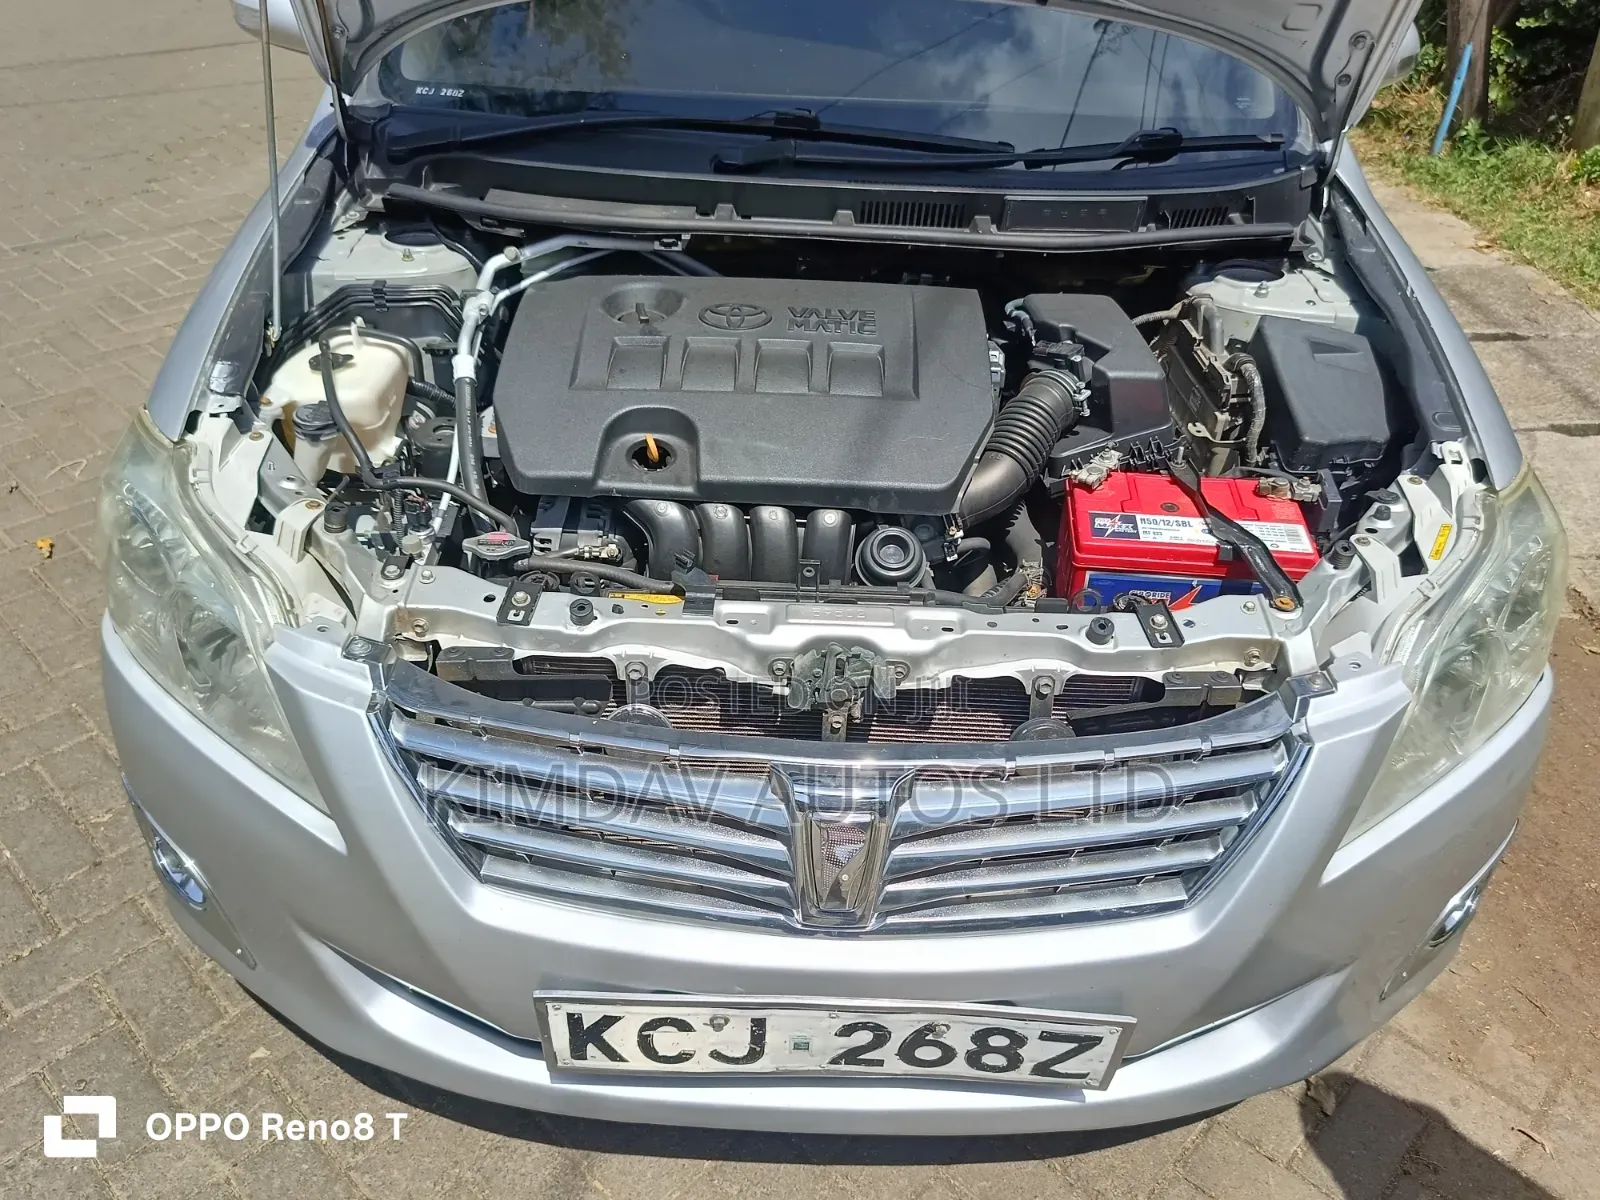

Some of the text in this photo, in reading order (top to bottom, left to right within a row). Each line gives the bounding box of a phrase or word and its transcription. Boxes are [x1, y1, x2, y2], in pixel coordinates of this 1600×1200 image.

[415, 86, 435, 95] KCJ
[787, 306, 876, 321] VALVE
[787, 318, 876, 336] MATIC
[566, 1012, 1105, 1080] KCJ 268Z
